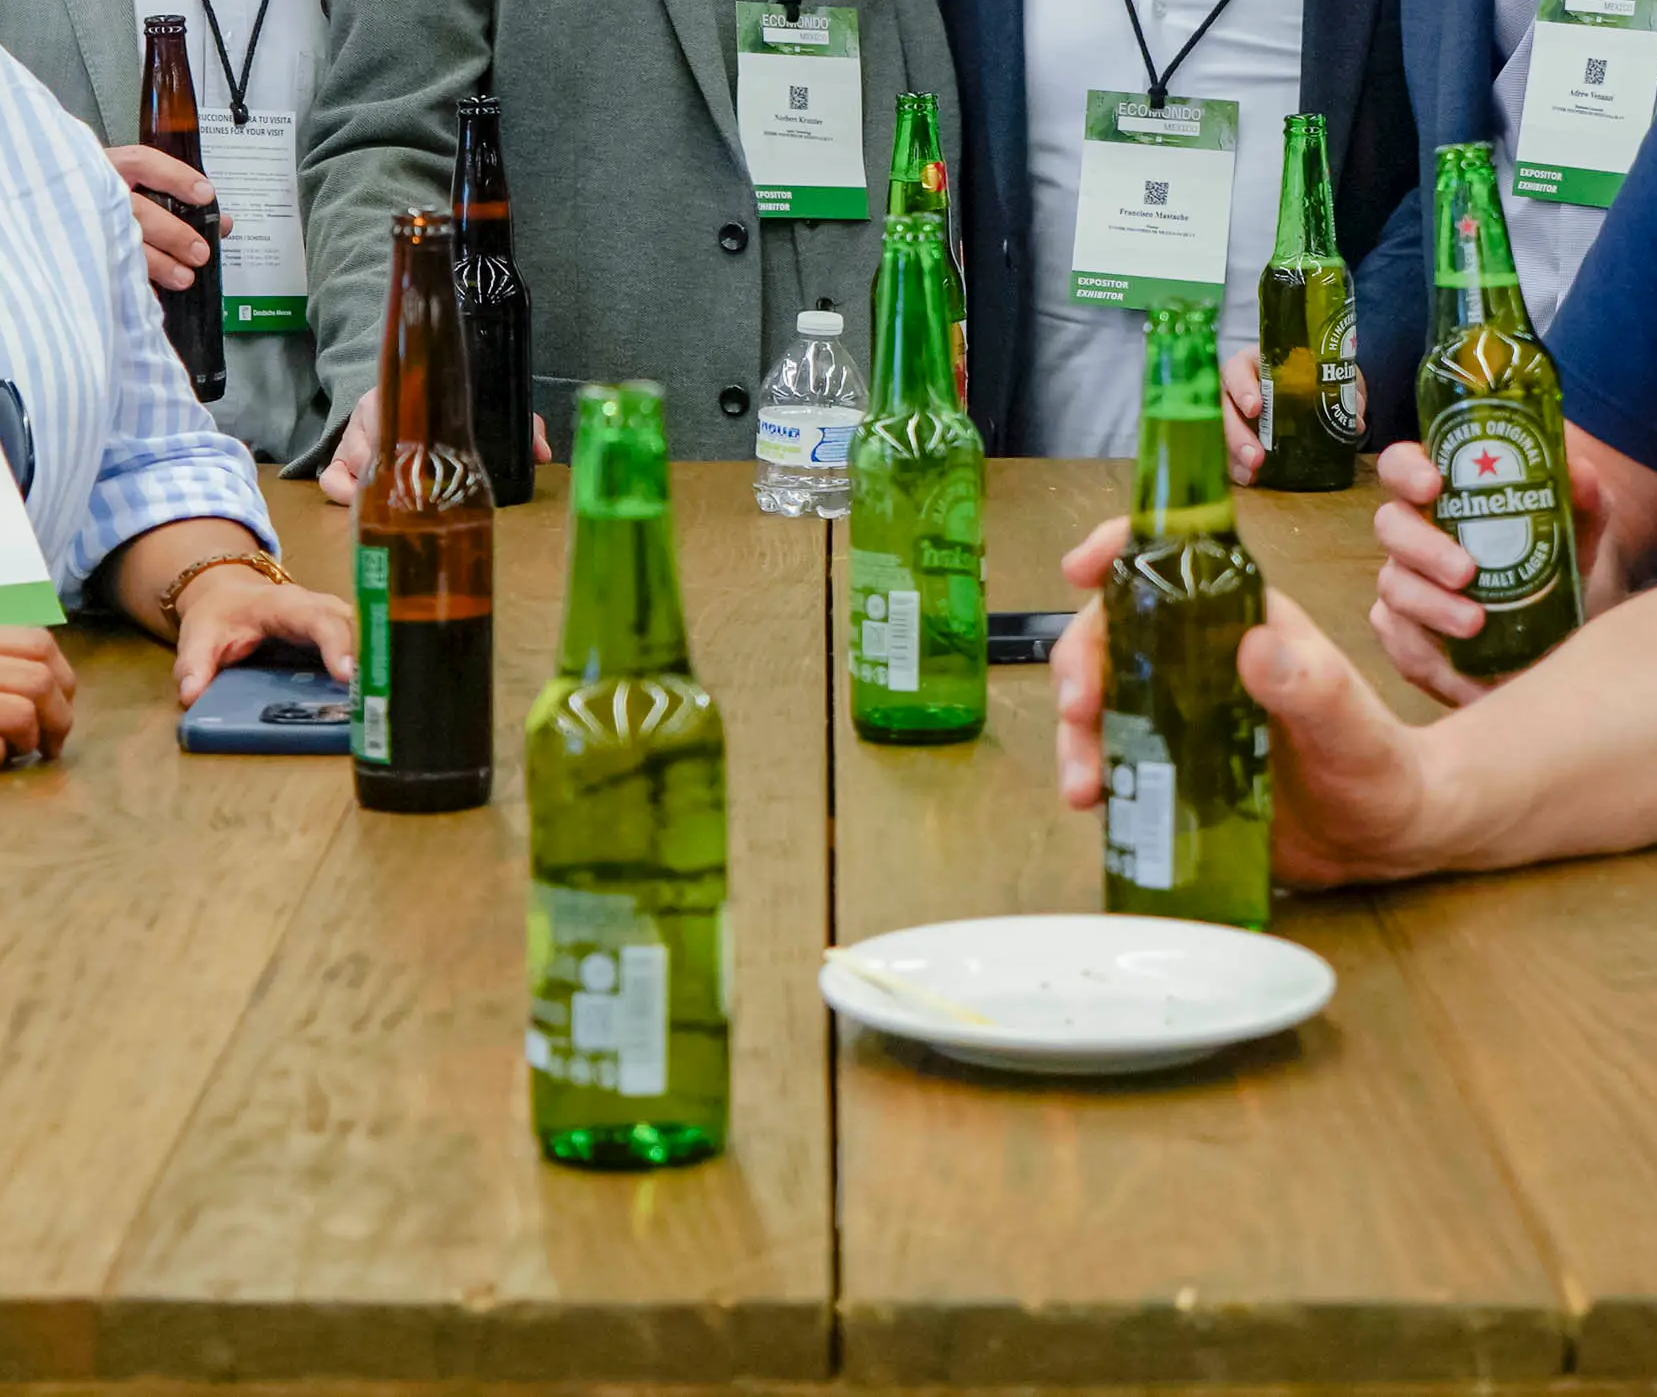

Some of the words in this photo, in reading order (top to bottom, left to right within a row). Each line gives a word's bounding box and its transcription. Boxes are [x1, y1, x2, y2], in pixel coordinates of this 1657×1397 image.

[201, 126, 229, 134] DELINES
[1520, 168, 1562, 181] EXPOSITOR
[1077, 277, 1129, 290] EXPOSITOR
[1076, 289, 1124, 302] EXHIBITOR
